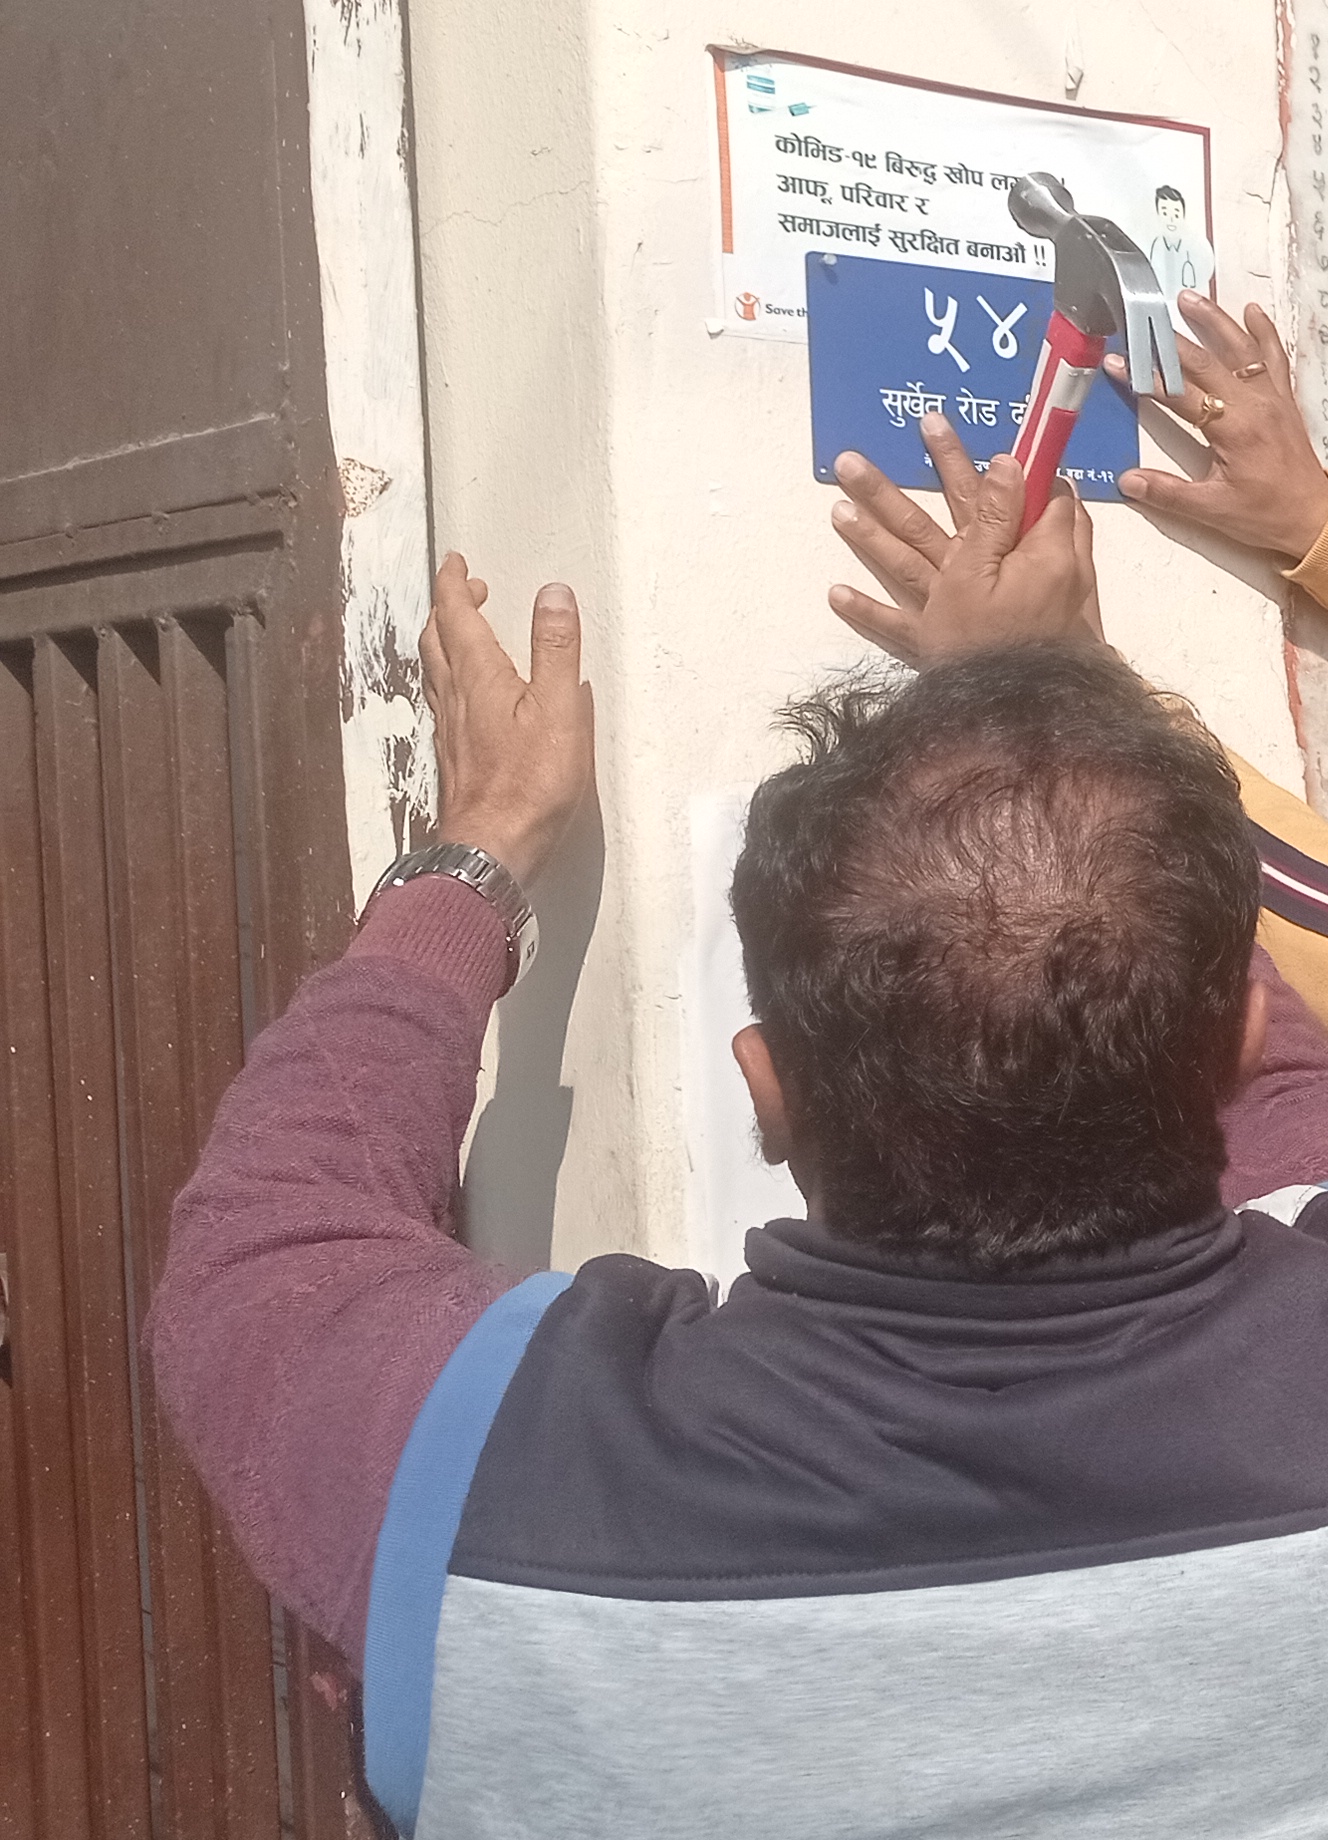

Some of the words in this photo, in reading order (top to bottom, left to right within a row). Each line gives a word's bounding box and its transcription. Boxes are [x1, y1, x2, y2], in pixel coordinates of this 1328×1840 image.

[943, 163, 984, 187] खोप
[841, 182, 908, 213] परिवार
[914, 197, 930, 216] र
[777, 212, 883, 248] समाजलाई
[888, 229, 960, 255] सुरक्षित
[764, 303, 795, 318] Save
[955, 387, 1001, 427] रोड
